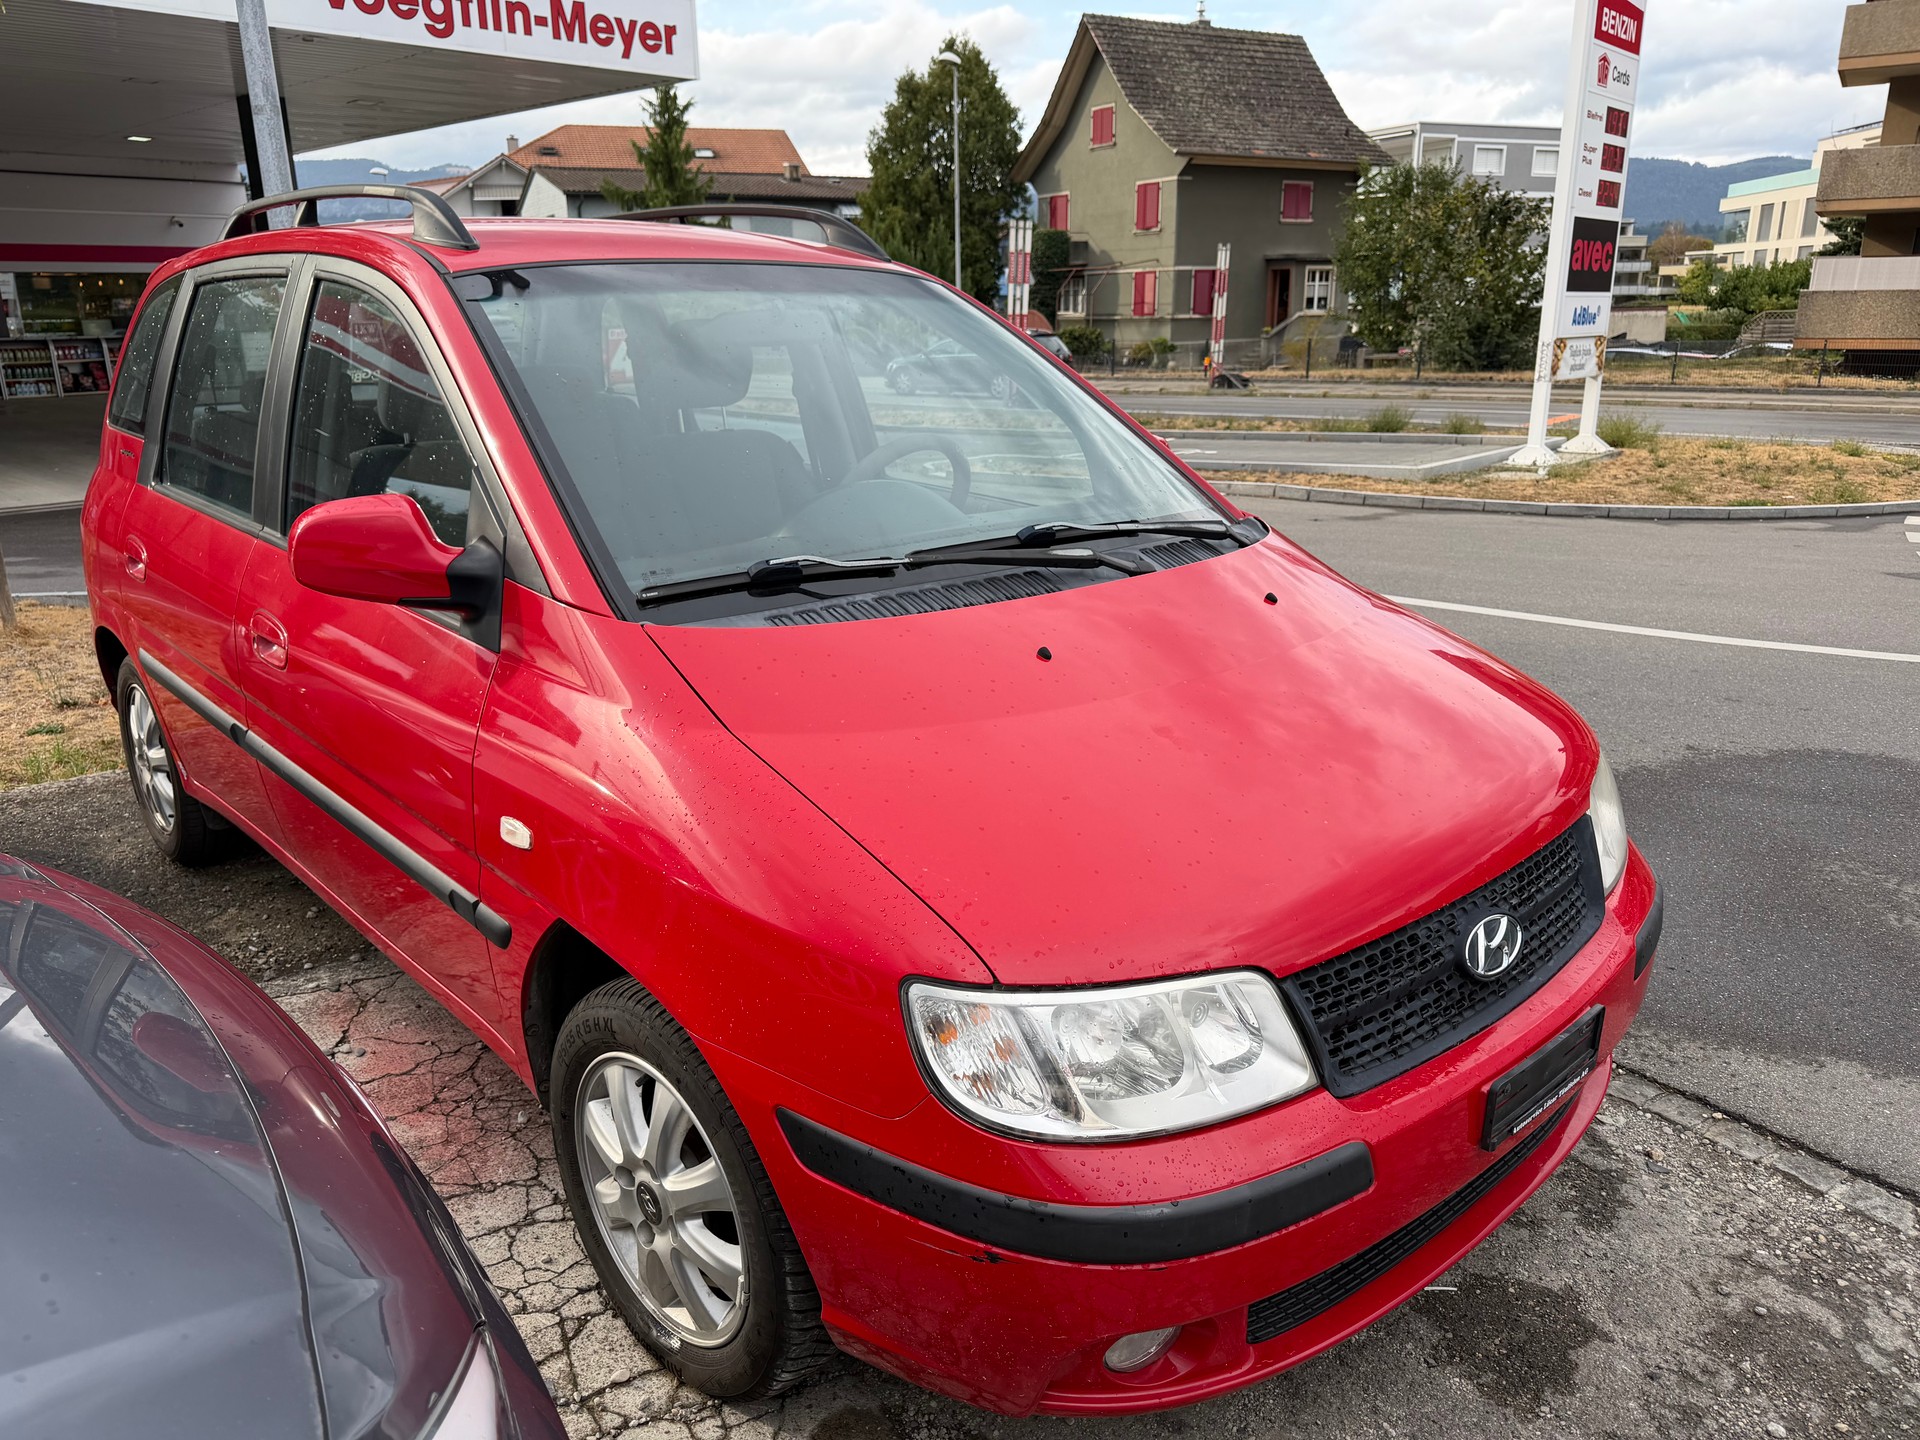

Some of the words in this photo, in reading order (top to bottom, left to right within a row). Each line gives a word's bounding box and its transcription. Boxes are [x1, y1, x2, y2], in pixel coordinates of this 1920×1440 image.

[328, 0, 677, 59] egtlin-Meyer
[1601, 7, 1638, 43] BENZIN
[1612, 65, 1631, 87] Cards
[1583, 143, 1598, 154] Super
[1582, 155, 1592, 166] Plus
[1578, 187, 1593, 198] Diesel
[1571, 238, 1613, 273] avec
[582, 1018, 592, 1035] 15
[593, 1016, 601, 1032] H
[602, 1016, 616, 1034] XL
